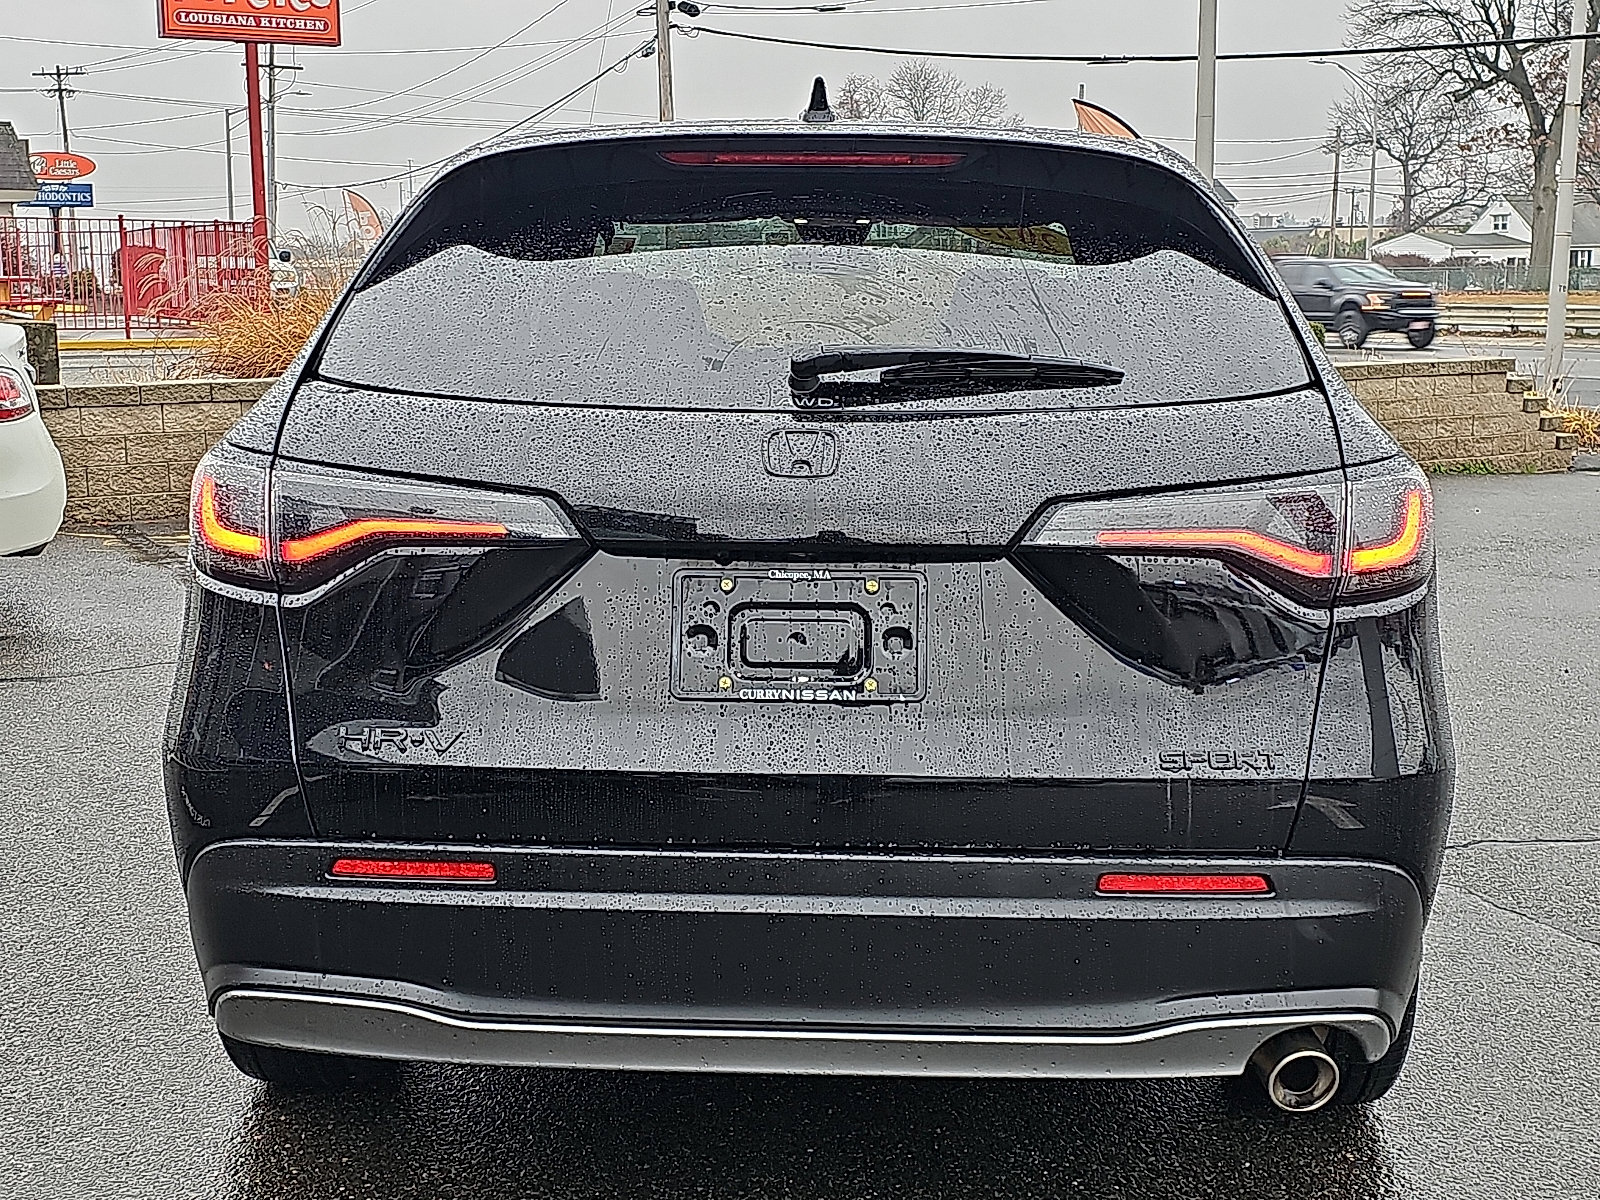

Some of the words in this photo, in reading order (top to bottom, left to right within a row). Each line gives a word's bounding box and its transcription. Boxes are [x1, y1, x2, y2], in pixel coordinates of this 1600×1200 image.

[179, 12, 258, 26] LOUISIANA
[259, 17, 326, 30] KITCHEN
[55, 159, 77, 168] Little
[49, 167, 80, 176] Caesars
[813, 569, 831, 579] MA
[739, 688, 781, 700] CURRY
[781, 689, 856, 701] NISSAN
[1159, 749, 1284, 775] SPORT
